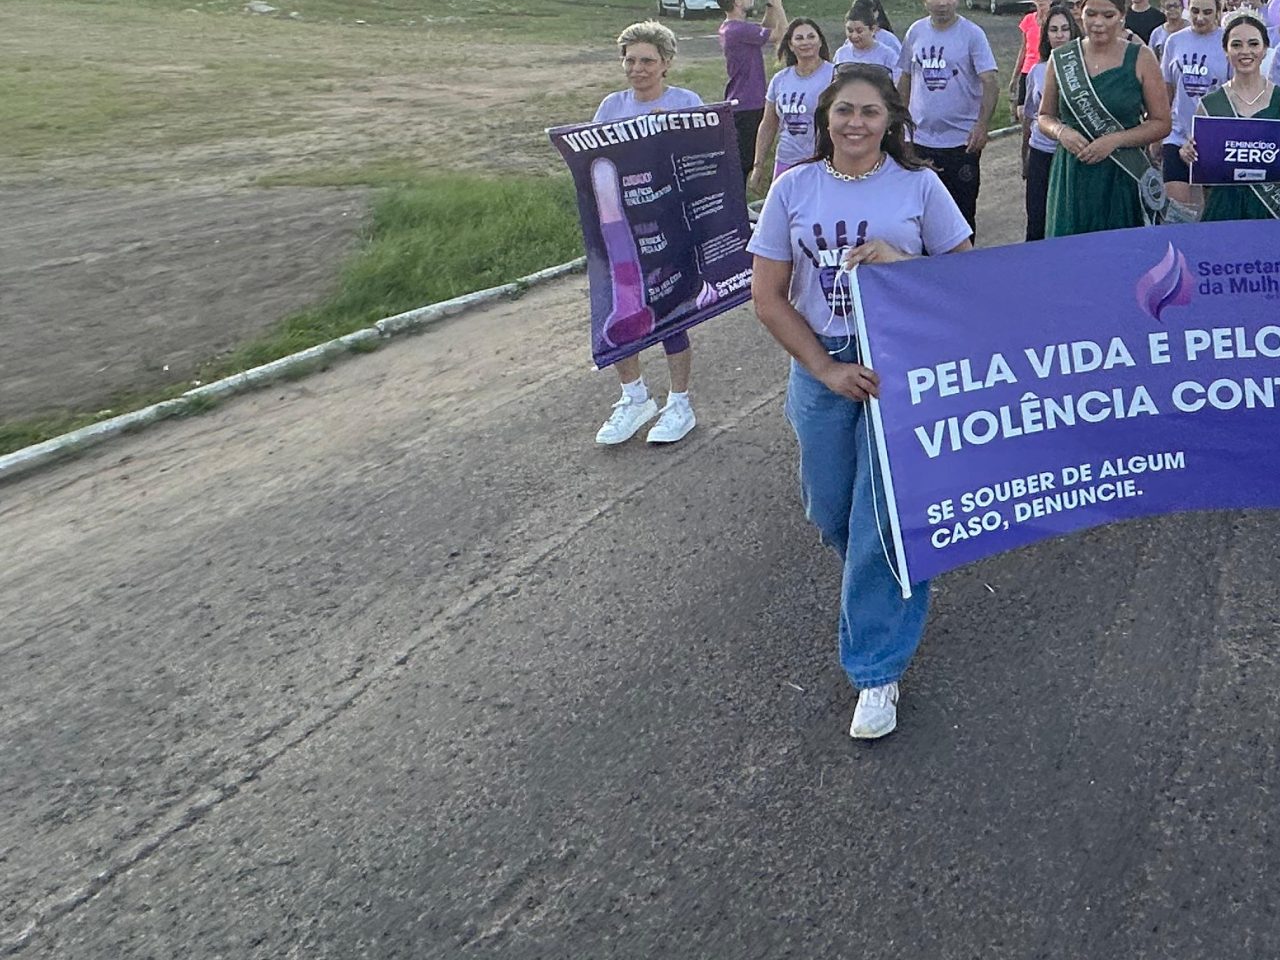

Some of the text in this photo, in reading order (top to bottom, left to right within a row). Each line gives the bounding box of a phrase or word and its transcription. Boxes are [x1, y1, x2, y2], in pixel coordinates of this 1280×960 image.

[1224, 148, 1279, 163] ZERO
[1225, 140, 1276, 150] FEMINICÍDIO
[1199, 279, 1223, 295] da
[907, 353, 1017, 405] PELA
[1024, 337, 1136, 378] VIDA
[1148, 332, 1171, 364] E
[914, 385, 1160, 459] VIOLÊNCIA
[927, 451, 1185, 526] SE SOUBER DE ALGUM
[930, 479, 1144, 550] CASO, DENUNCIE.
